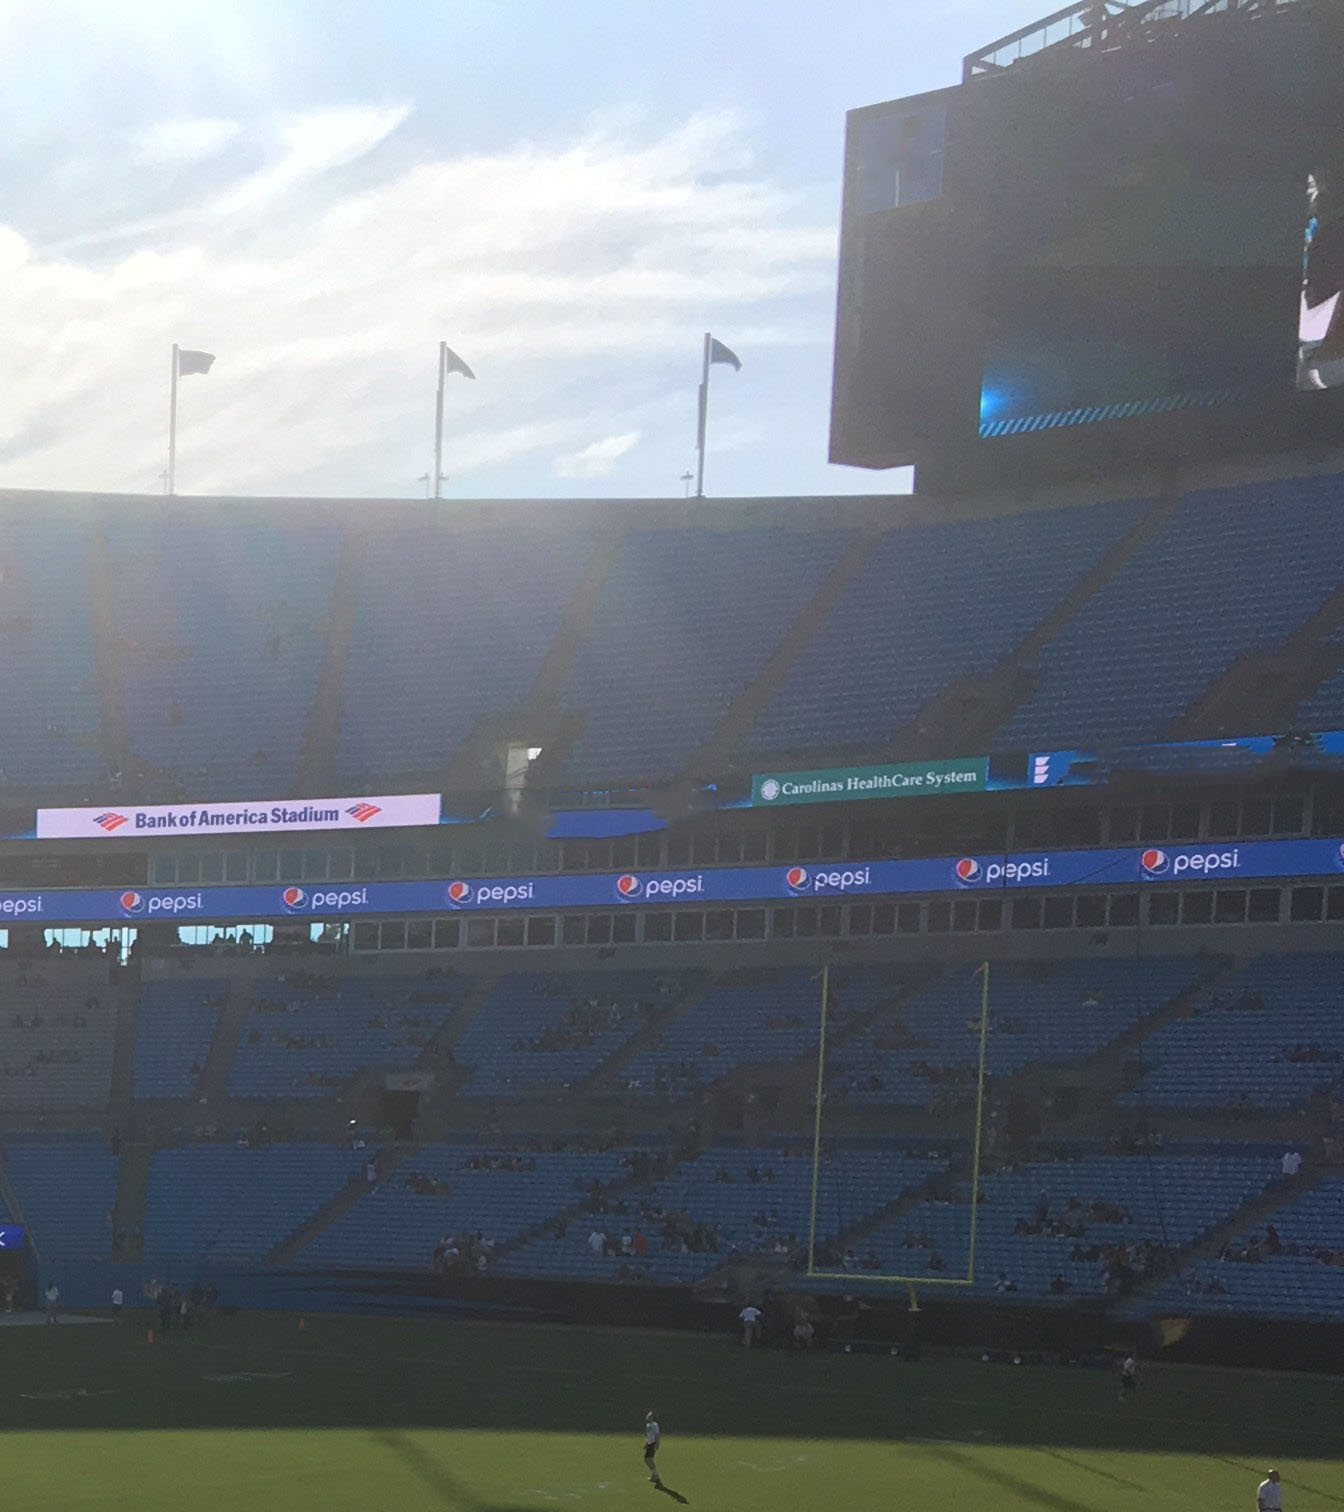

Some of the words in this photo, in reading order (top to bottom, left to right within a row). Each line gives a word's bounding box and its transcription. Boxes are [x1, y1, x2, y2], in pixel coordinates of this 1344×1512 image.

[782, 780, 843, 795] Carolinas
[847, 772, 922, 791] HealthCare
[926, 770, 977, 787] System
[135, 812, 178, 829] Bank
[180, 811, 199, 828] of
[199, 809, 268, 827] America
[272, 807, 339, 824] Stadium
[986, 858, 1049, 882] pepsi
[1173, 849, 1239, 875] pepsi
[646, 875, 703, 898] pepsi
[815, 867, 870, 891] pepsi
[148, 893, 203, 913] pepsi
[312, 887, 367, 909] pepsi
[477, 882, 534, 904] pepsi
